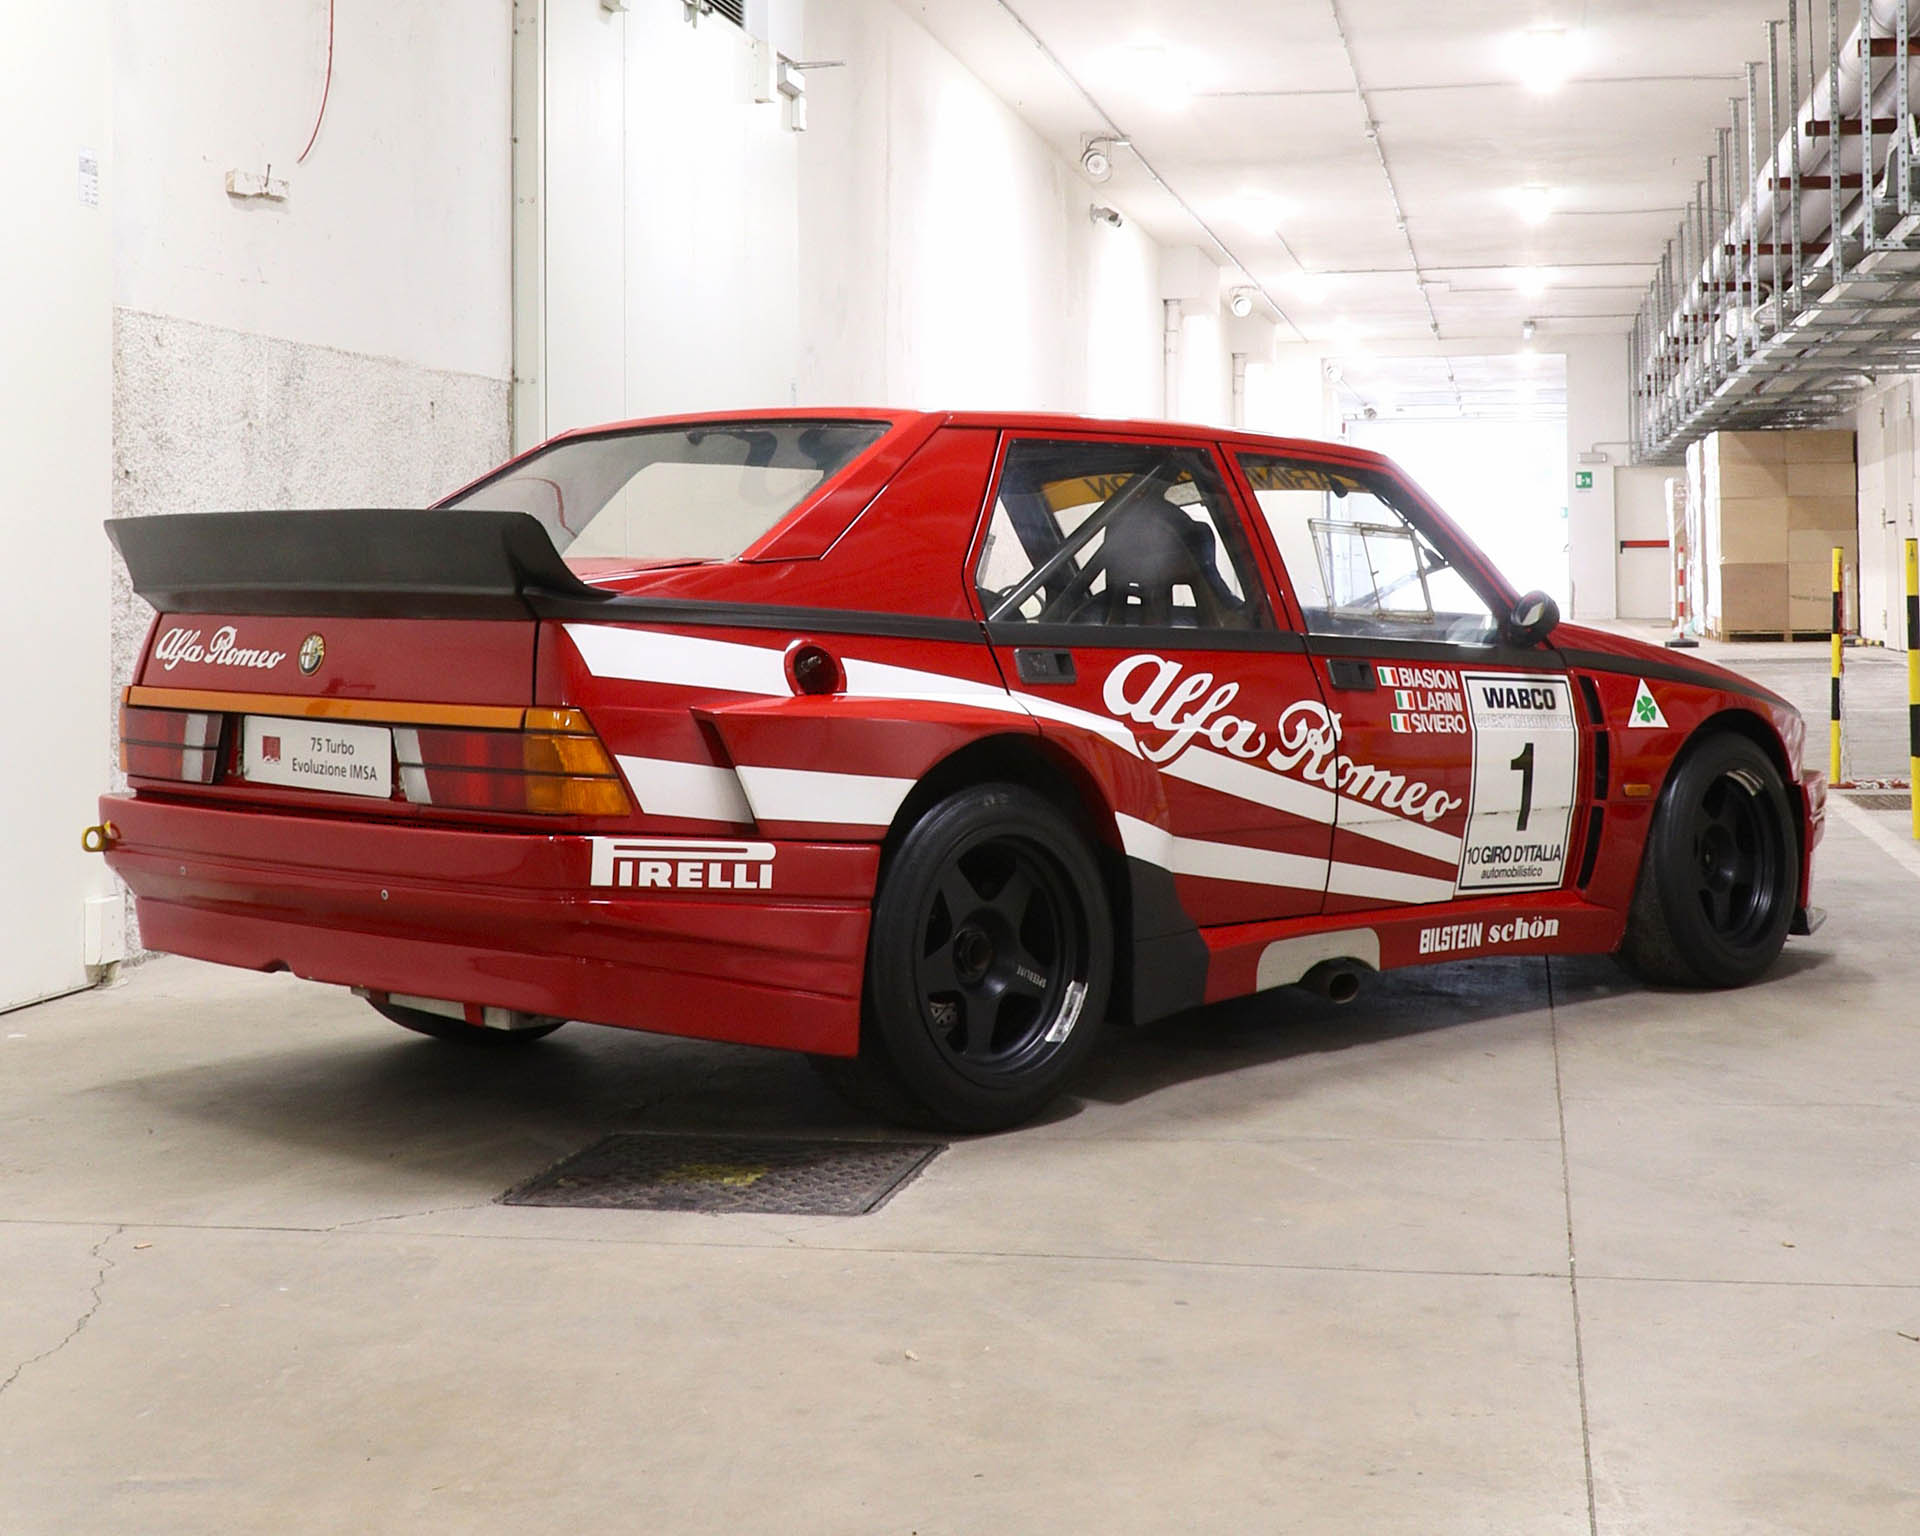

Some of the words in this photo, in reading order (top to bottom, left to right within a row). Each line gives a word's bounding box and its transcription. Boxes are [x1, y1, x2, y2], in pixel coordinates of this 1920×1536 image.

[155, 628, 205, 671] Alfa
[204, 626, 286, 669] Romeo
[1398, 667, 1459, 689] BIASION
[1416, 691, 1463, 711] LARINI
[1482, 687, 1556, 710] WABCO
[1411, 713, 1467, 734] SIVIERO
[311, 737, 322, 752] 75
[326, 739, 355, 755] Turbo
[1103, 654, 1266, 762] Alfa
[1267, 700, 1462, 822] Romeo
[292, 758, 347, 778] Evoluzione
[350, 764, 377, 781] IMSA
[1511, 742, 1535, 832] 1
[590, 837, 776, 889] PIRELLI
[1481, 845, 1512, 863] GIRO
[1514, 844, 1561, 862] D'ITALIA
[1481, 865, 1543, 879] automobilistico
[1419, 922, 1483, 954] BILSTEIN
[1488, 915, 1559, 943] schön
